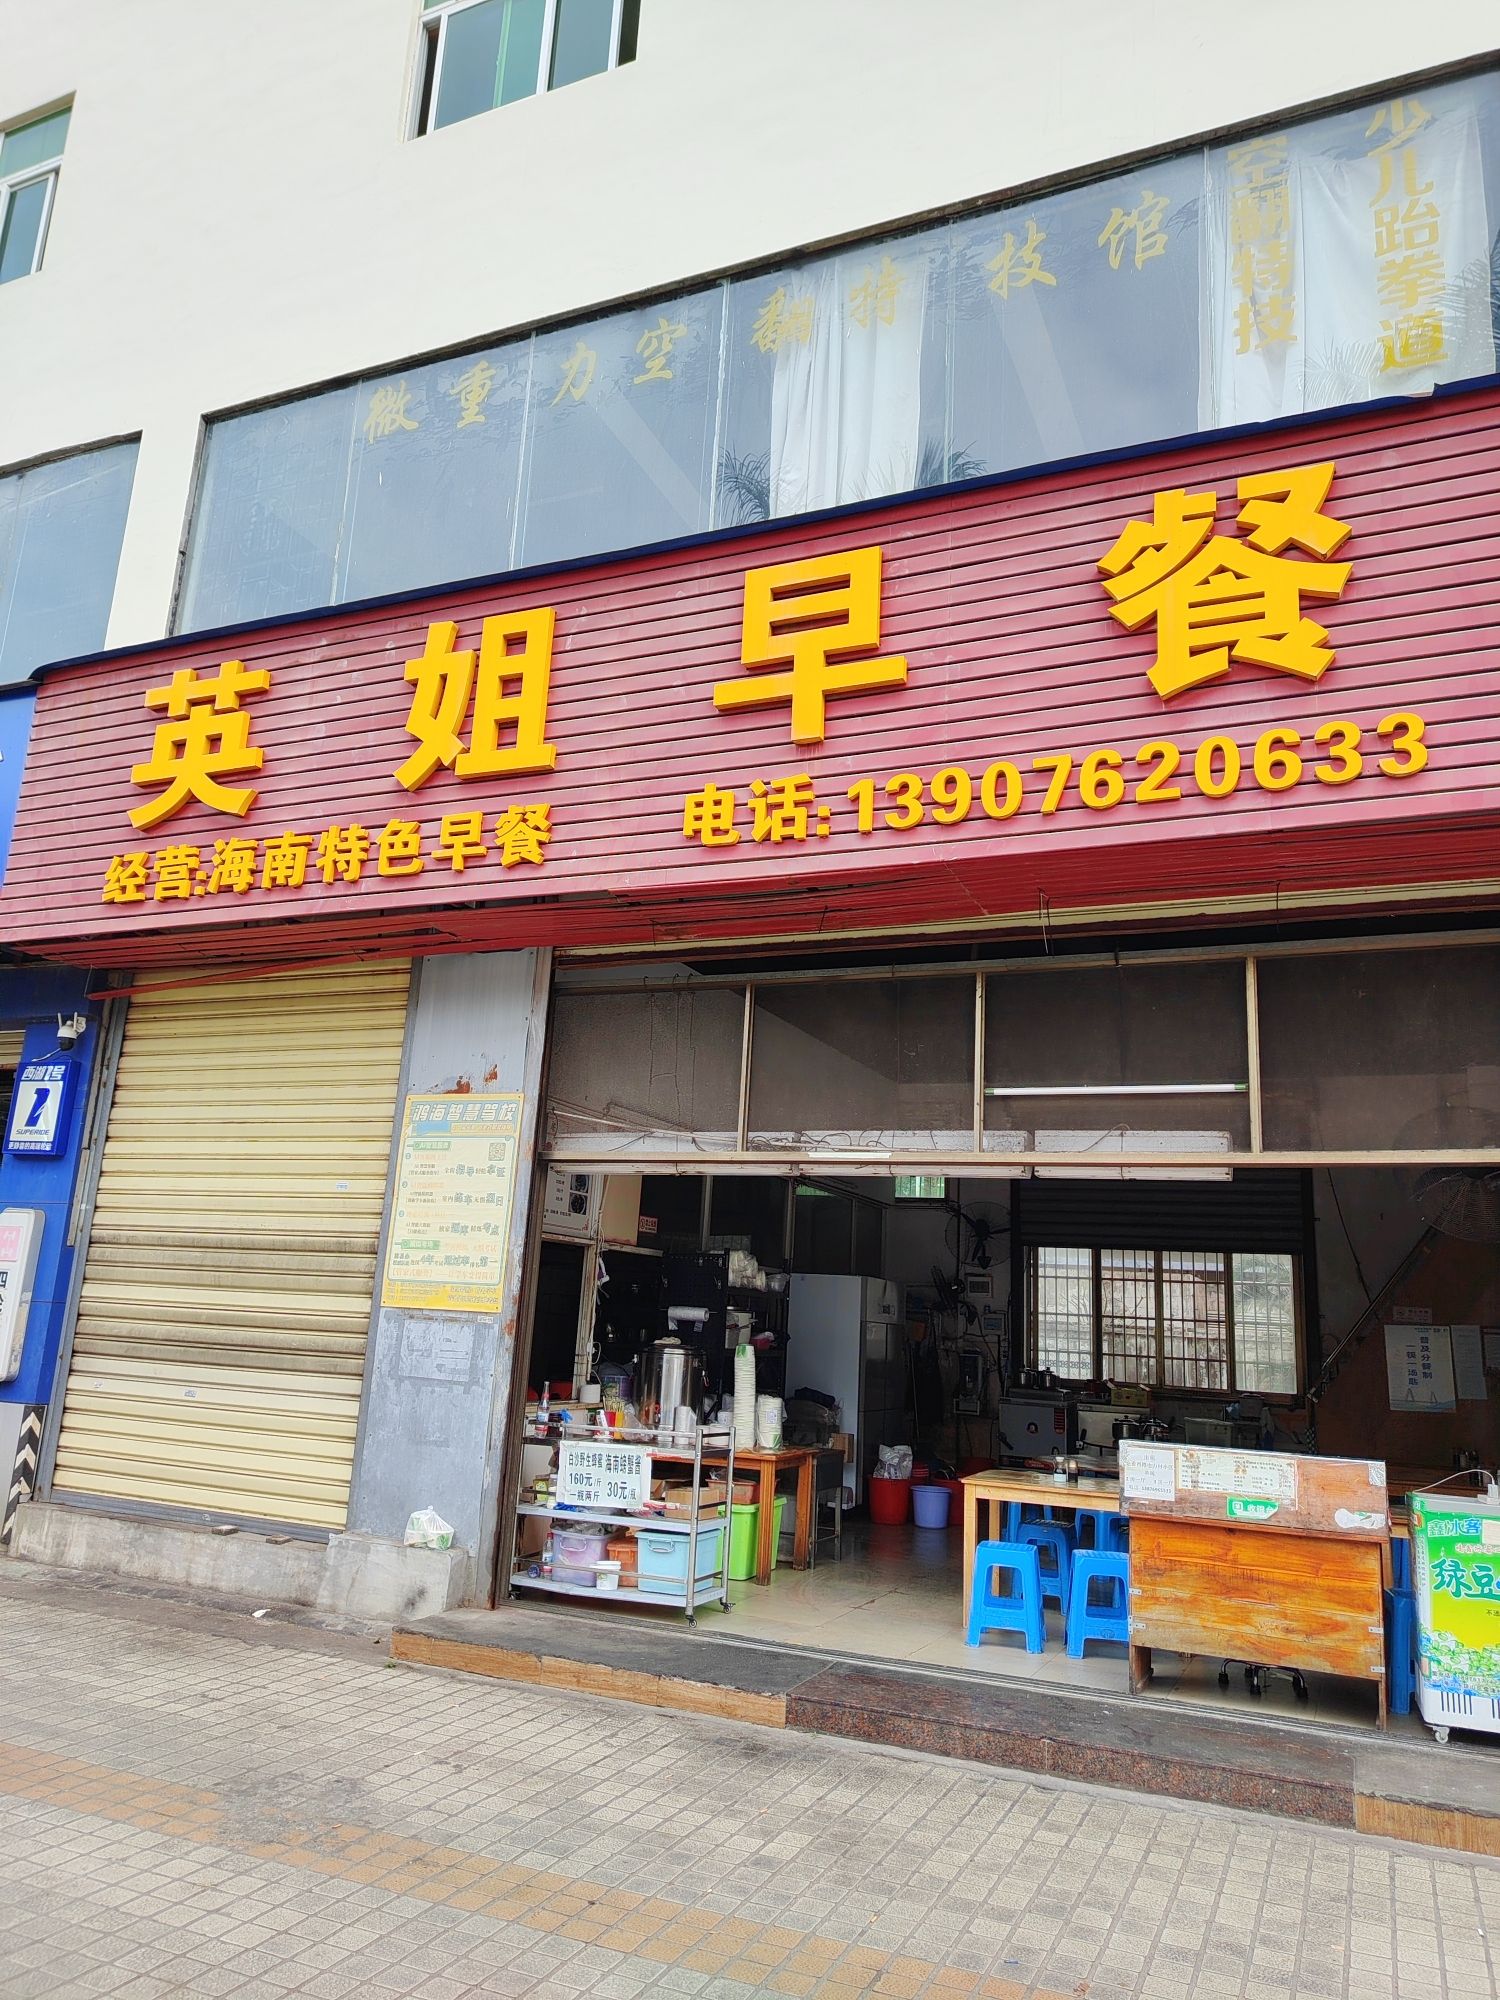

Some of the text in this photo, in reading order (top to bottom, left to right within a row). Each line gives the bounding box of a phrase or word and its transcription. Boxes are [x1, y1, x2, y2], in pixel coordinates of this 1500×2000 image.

[1227, 135, 1298, 356] 空翻特技
[1366, 98, 1449, 373] 少儿跆拳道
[128, 462, 1353, 831] 英姐早餐
[412, 1103, 518, 1121] 鸿海智慧驾校
[1427, 1518, 1482, 1538] 鑫冰客
[1431, 1557, 1500, 1602] 绿豆
